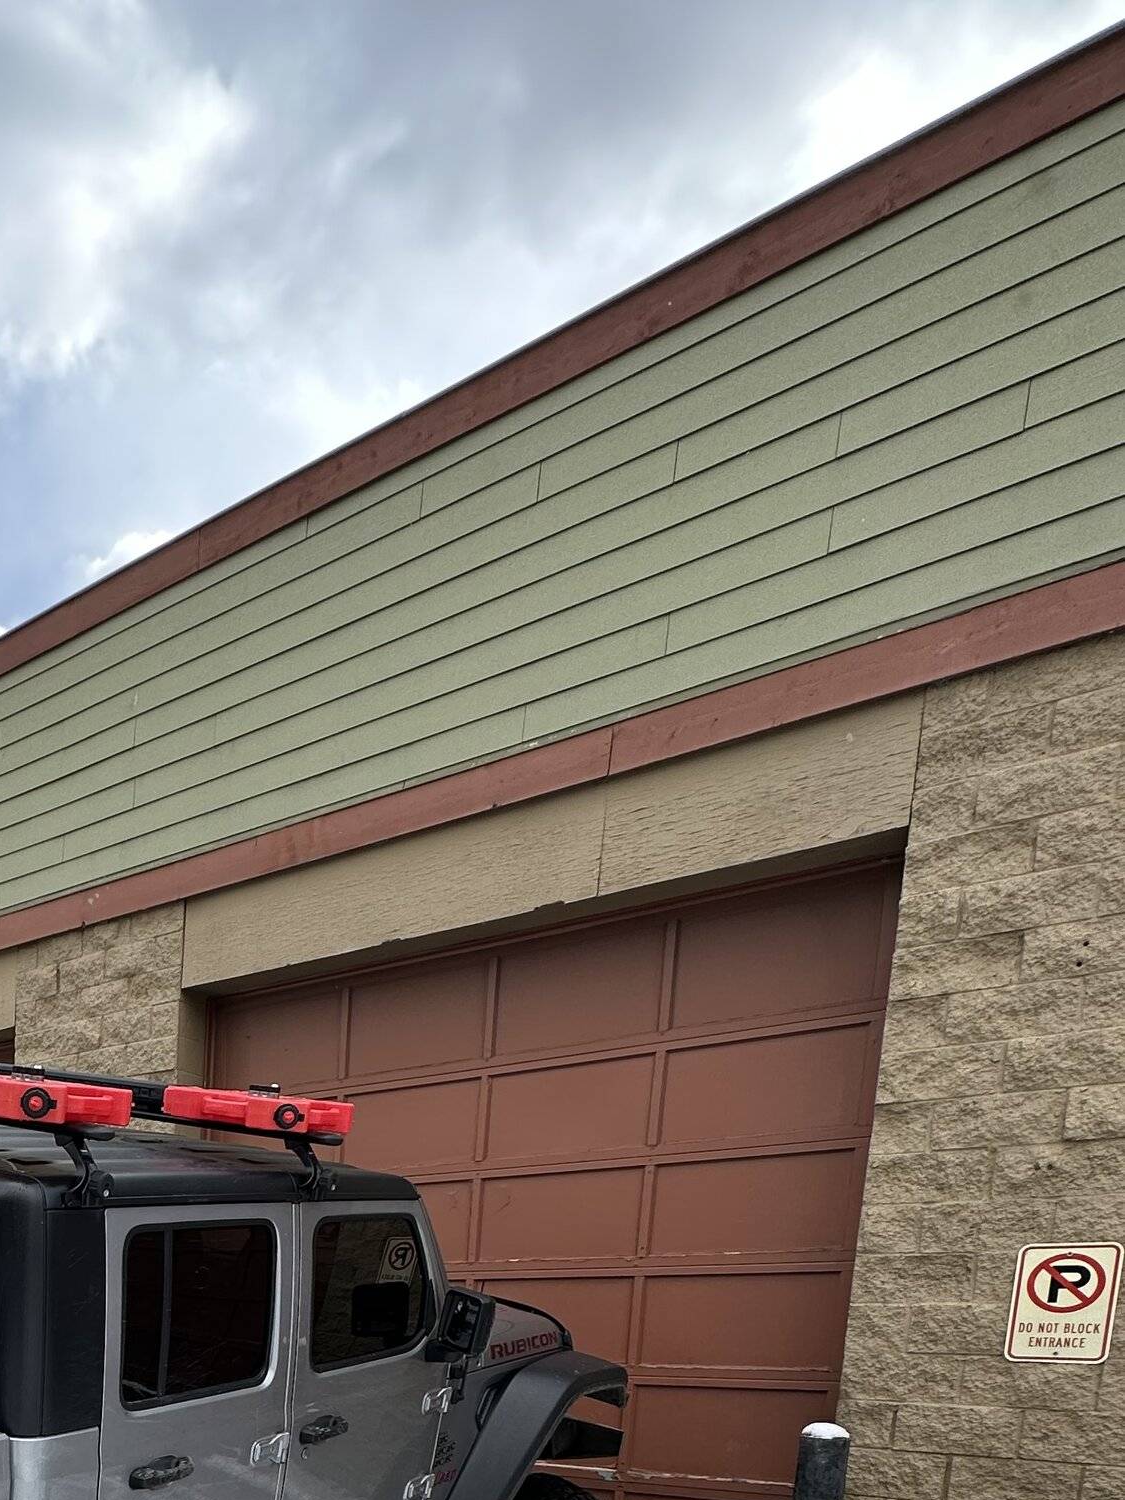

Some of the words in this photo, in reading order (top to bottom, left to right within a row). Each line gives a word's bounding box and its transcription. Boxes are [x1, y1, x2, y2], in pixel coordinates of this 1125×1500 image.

[1018, 1322, 1033, 1333] DO
[1038, 1322, 1059, 1334] NOT
[1063, 1322, 1101, 1334] BLOCK
[490, 1331, 558, 1360] RUBICON
[1028, 1336, 1086, 1348] ENTRANCE
